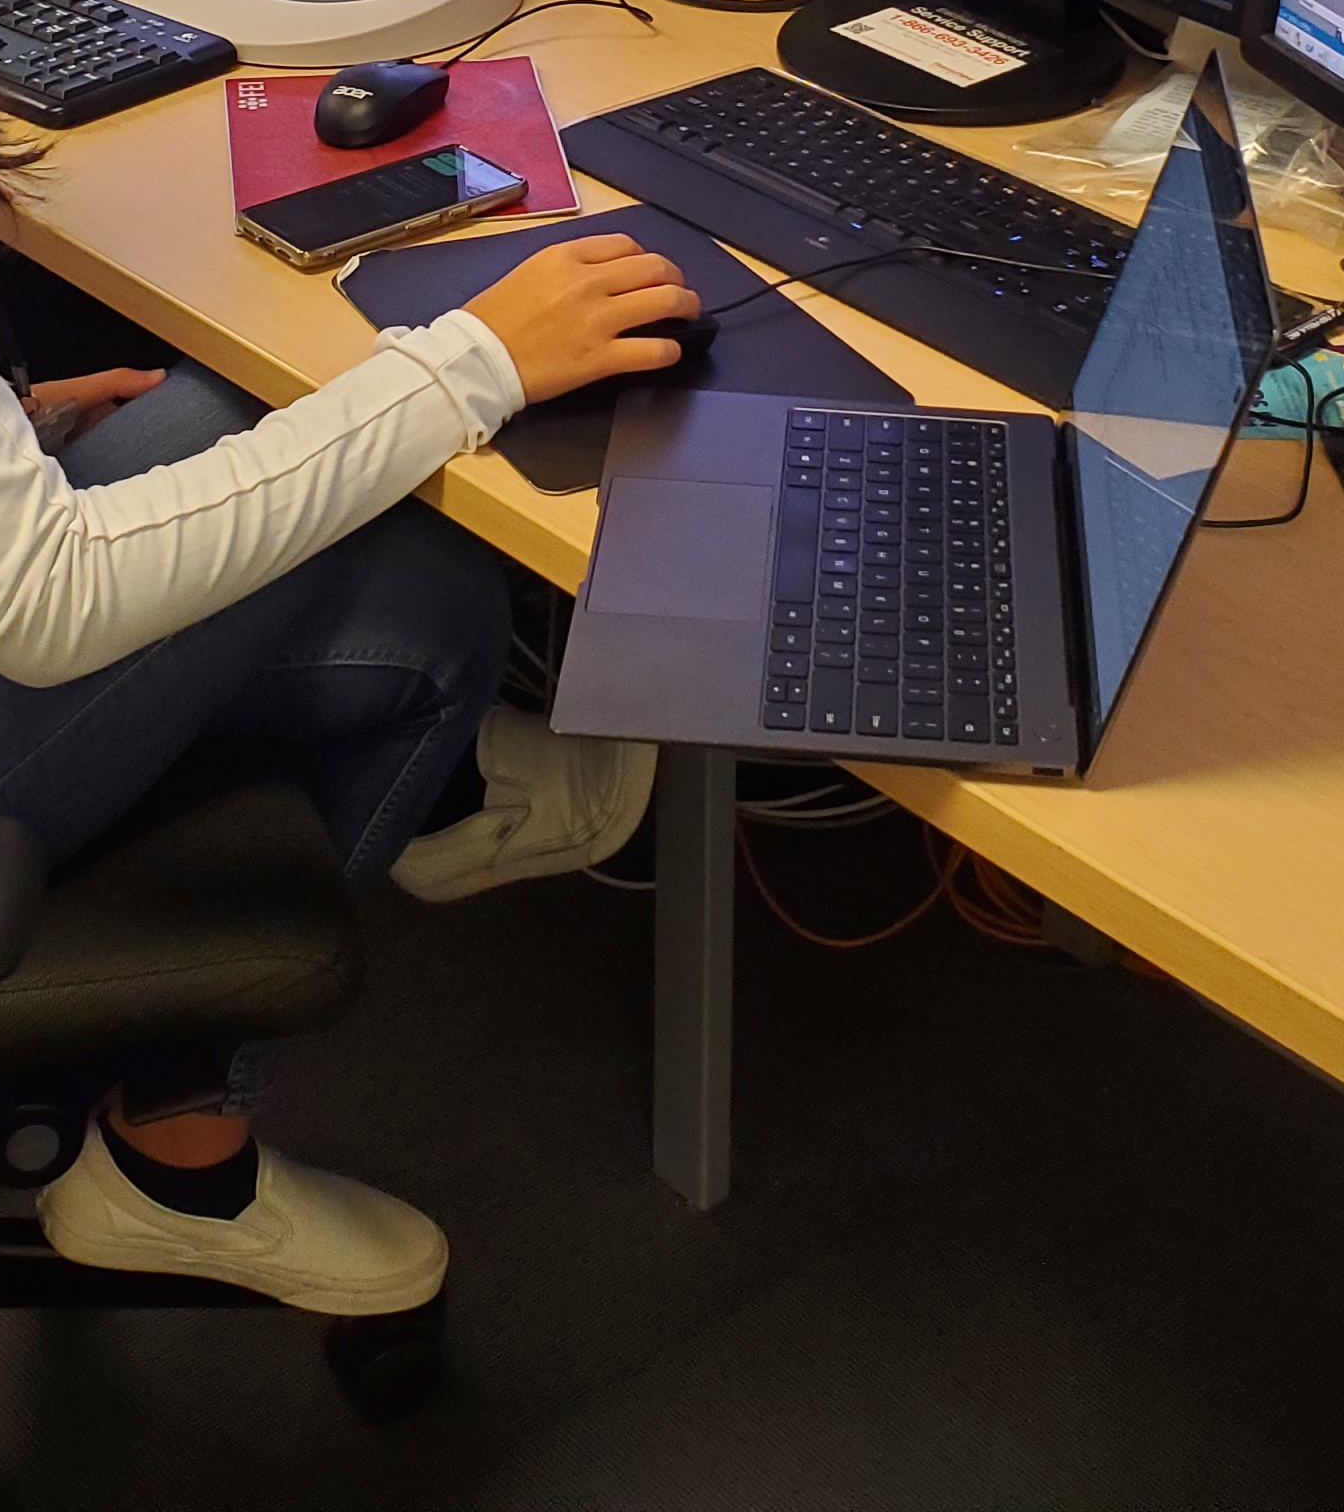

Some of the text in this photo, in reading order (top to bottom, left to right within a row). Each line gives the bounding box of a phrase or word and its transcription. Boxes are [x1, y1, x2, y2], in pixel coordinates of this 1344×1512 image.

[910, 6, 966, 32] Service
[966, 28, 1031, 57] Support
[332, 85, 374, 101] acer
